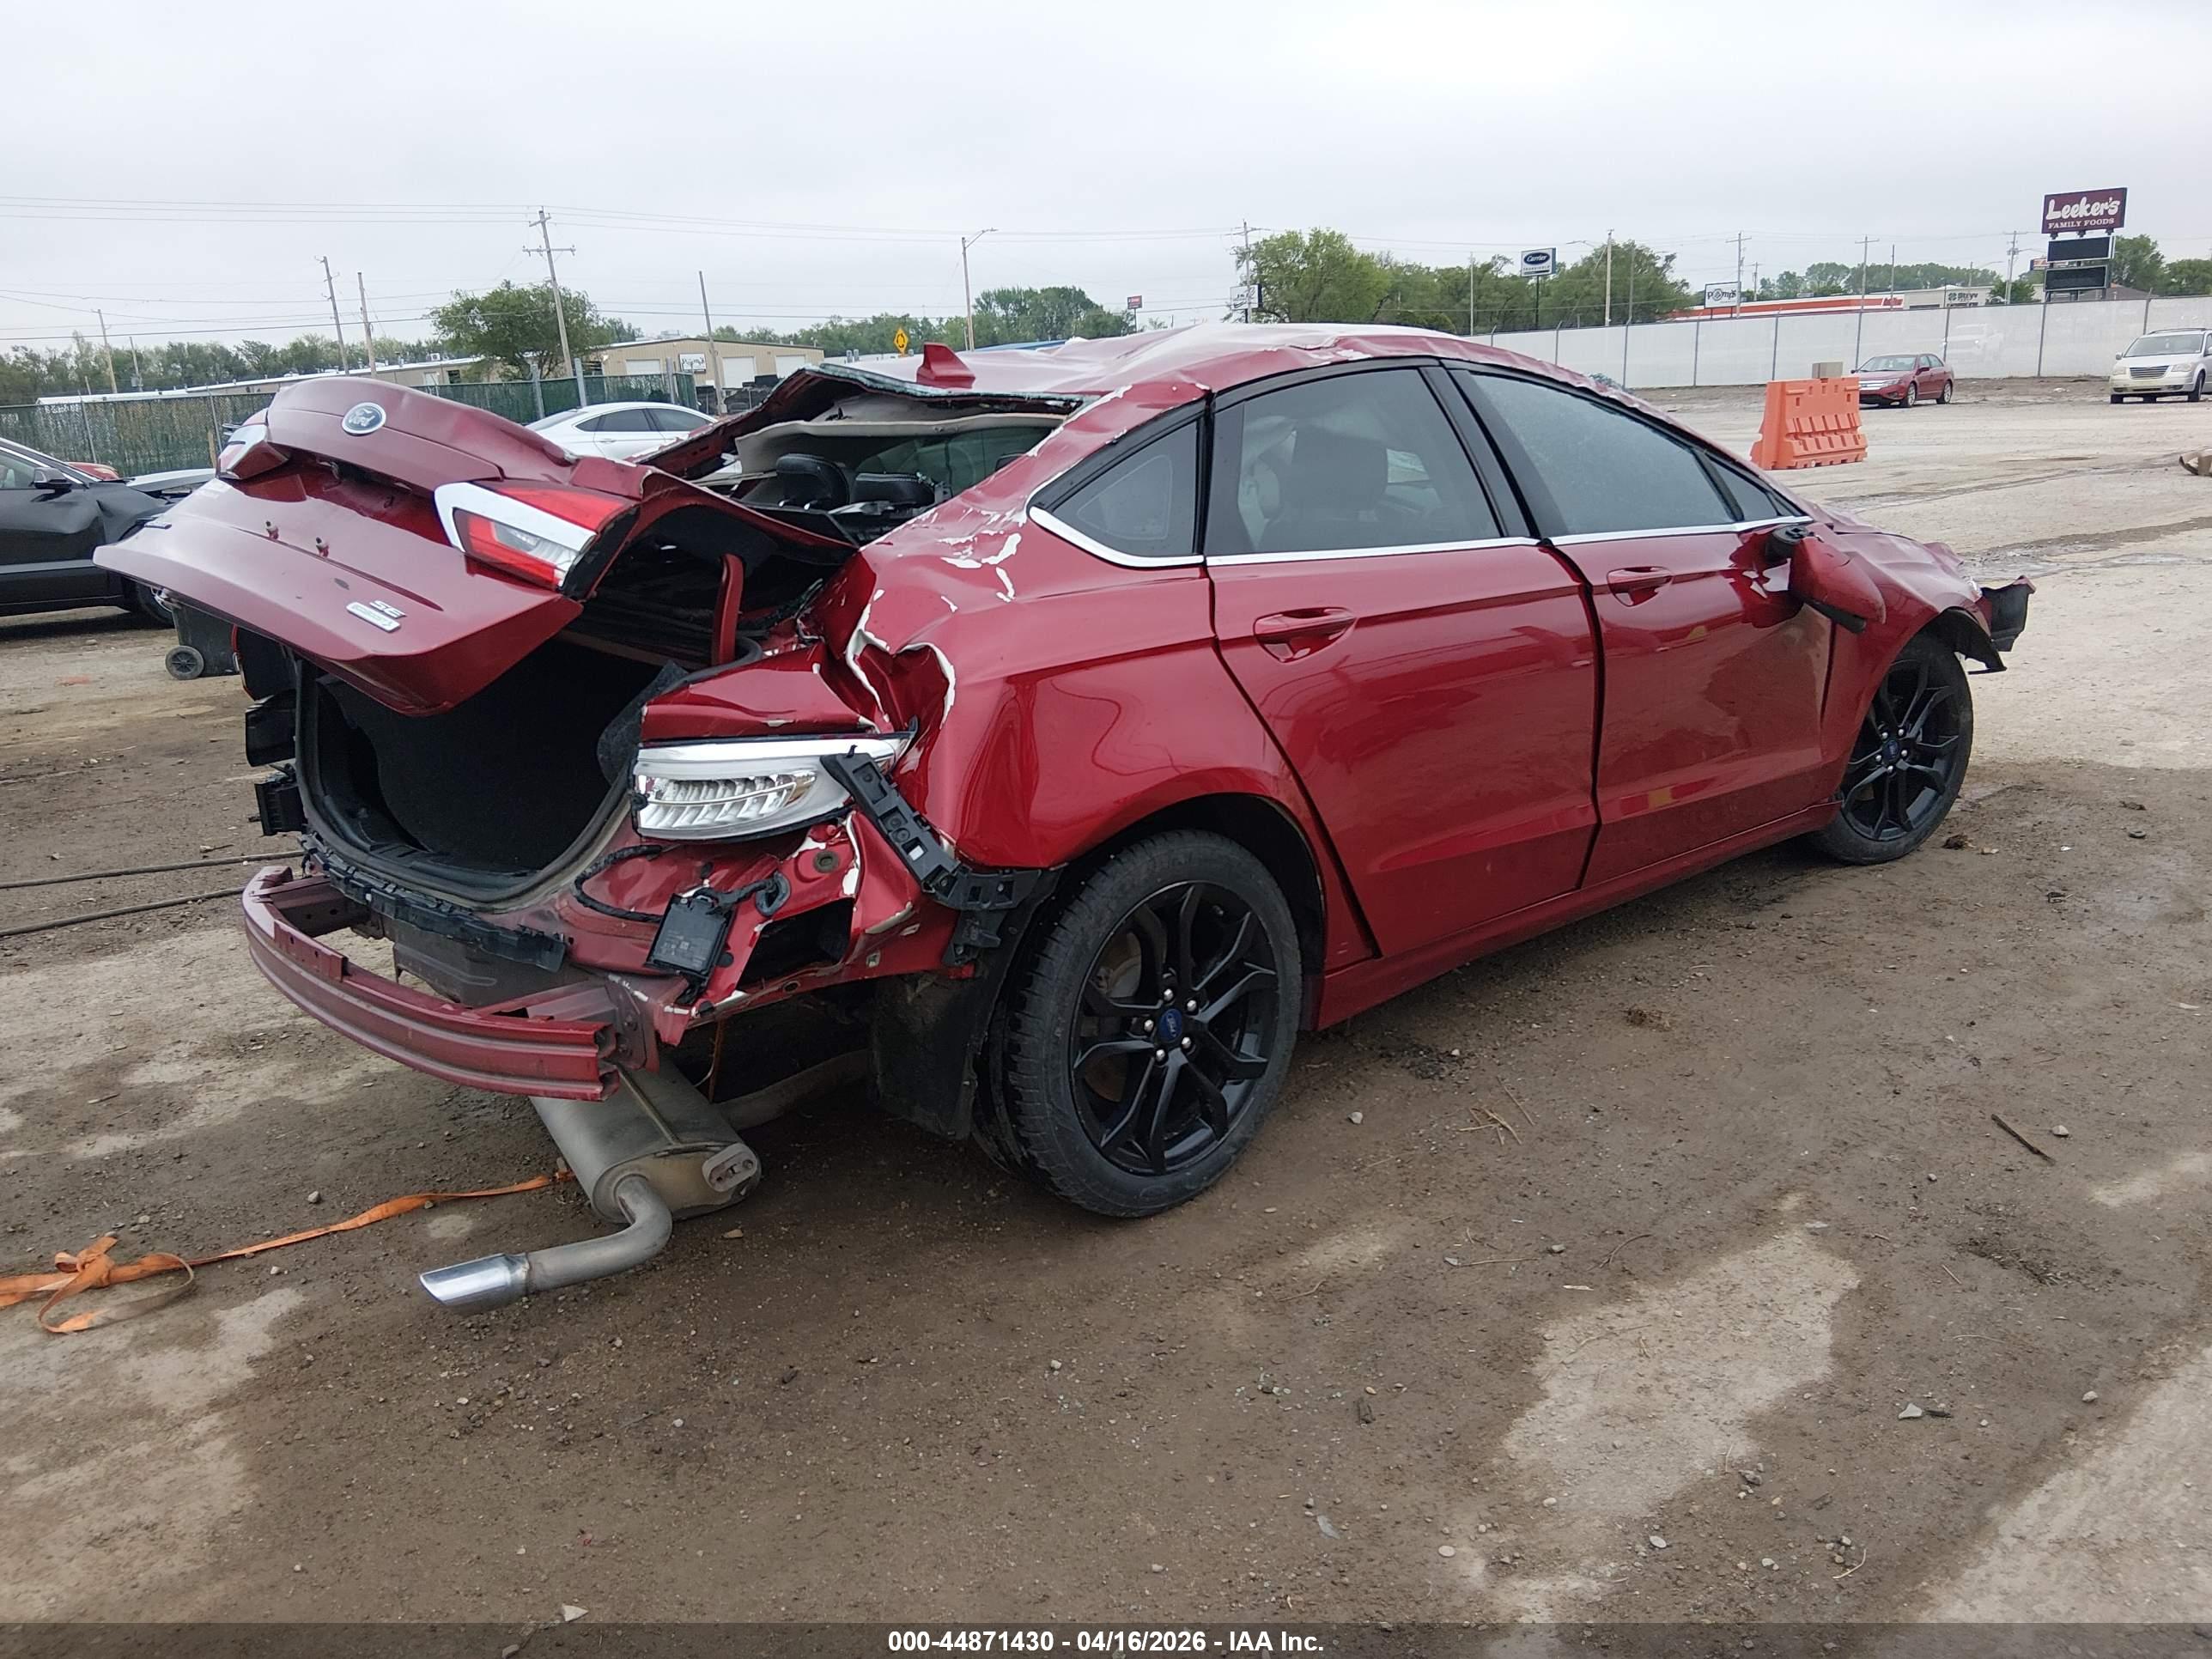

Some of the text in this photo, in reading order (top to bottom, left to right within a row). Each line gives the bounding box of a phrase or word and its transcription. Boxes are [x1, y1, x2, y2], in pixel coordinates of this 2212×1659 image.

[2045, 196, 2121, 221] Leeker's
[2048, 217, 2115, 229] FAMILY FOODS
[369, 600, 407, 618] SE
